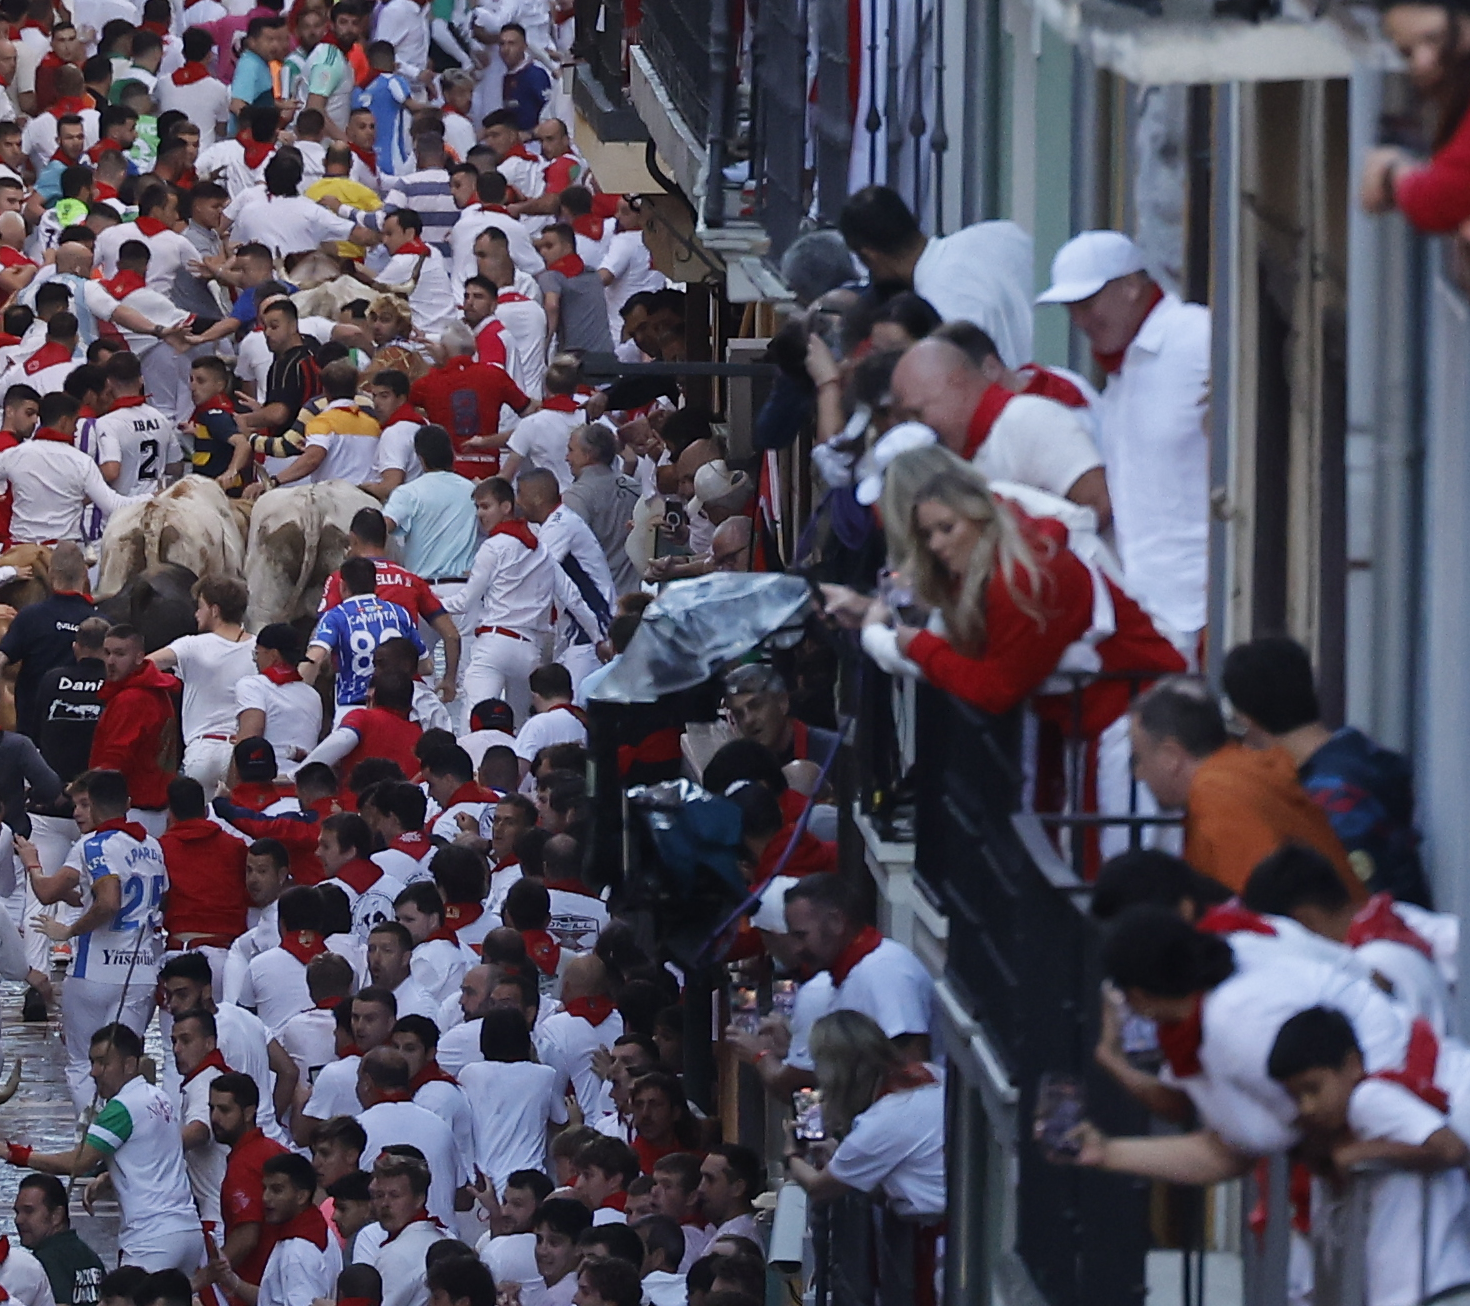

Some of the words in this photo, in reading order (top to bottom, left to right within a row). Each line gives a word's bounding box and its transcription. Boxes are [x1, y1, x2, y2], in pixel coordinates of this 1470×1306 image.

[133, 417, 160, 432] IBAI
[138, 439, 159, 481] 2
[58, 676, 104, 692] Dani
